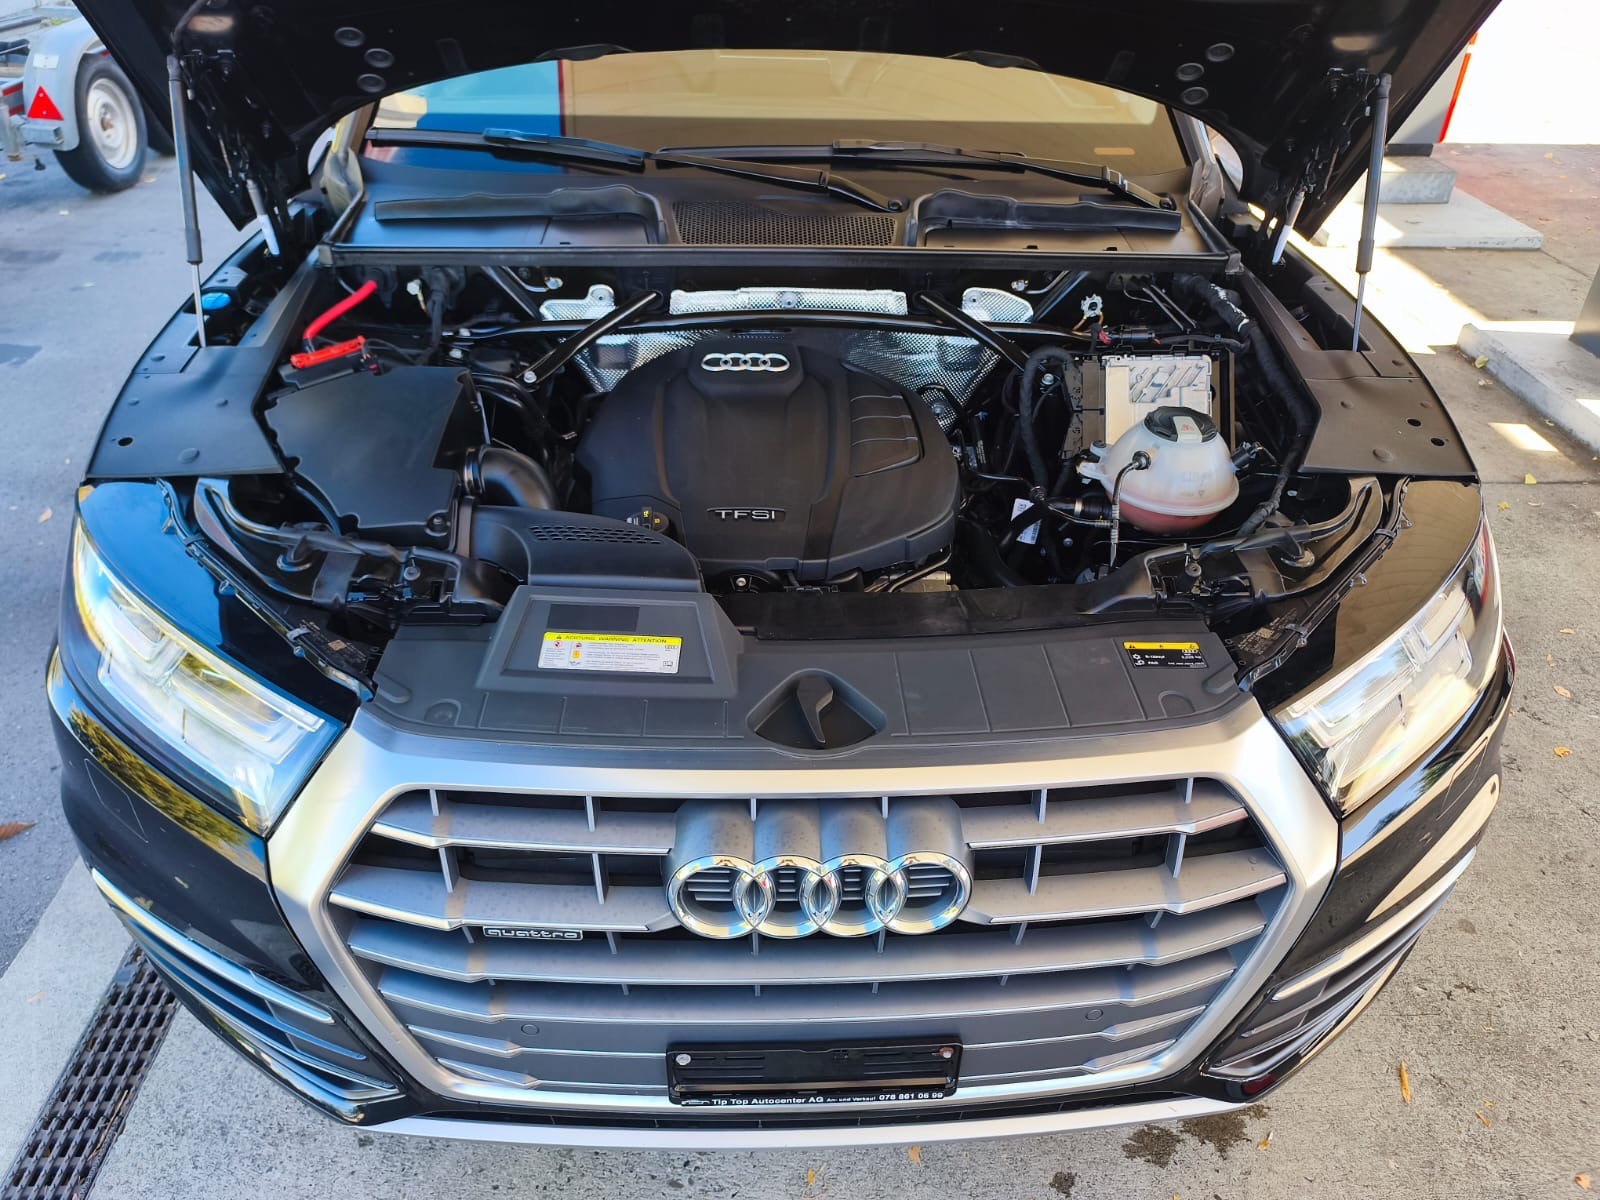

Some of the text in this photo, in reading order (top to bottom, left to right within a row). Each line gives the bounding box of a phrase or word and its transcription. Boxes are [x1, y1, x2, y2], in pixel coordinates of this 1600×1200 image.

[714, 510, 775, 519] TFSI
[487, 929, 578, 939] quattro
[712, 1098, 727, 1106] Tip
[731, 1098, 749, 1106] Top
[751, 1097, 807, 1105] Autocenter
